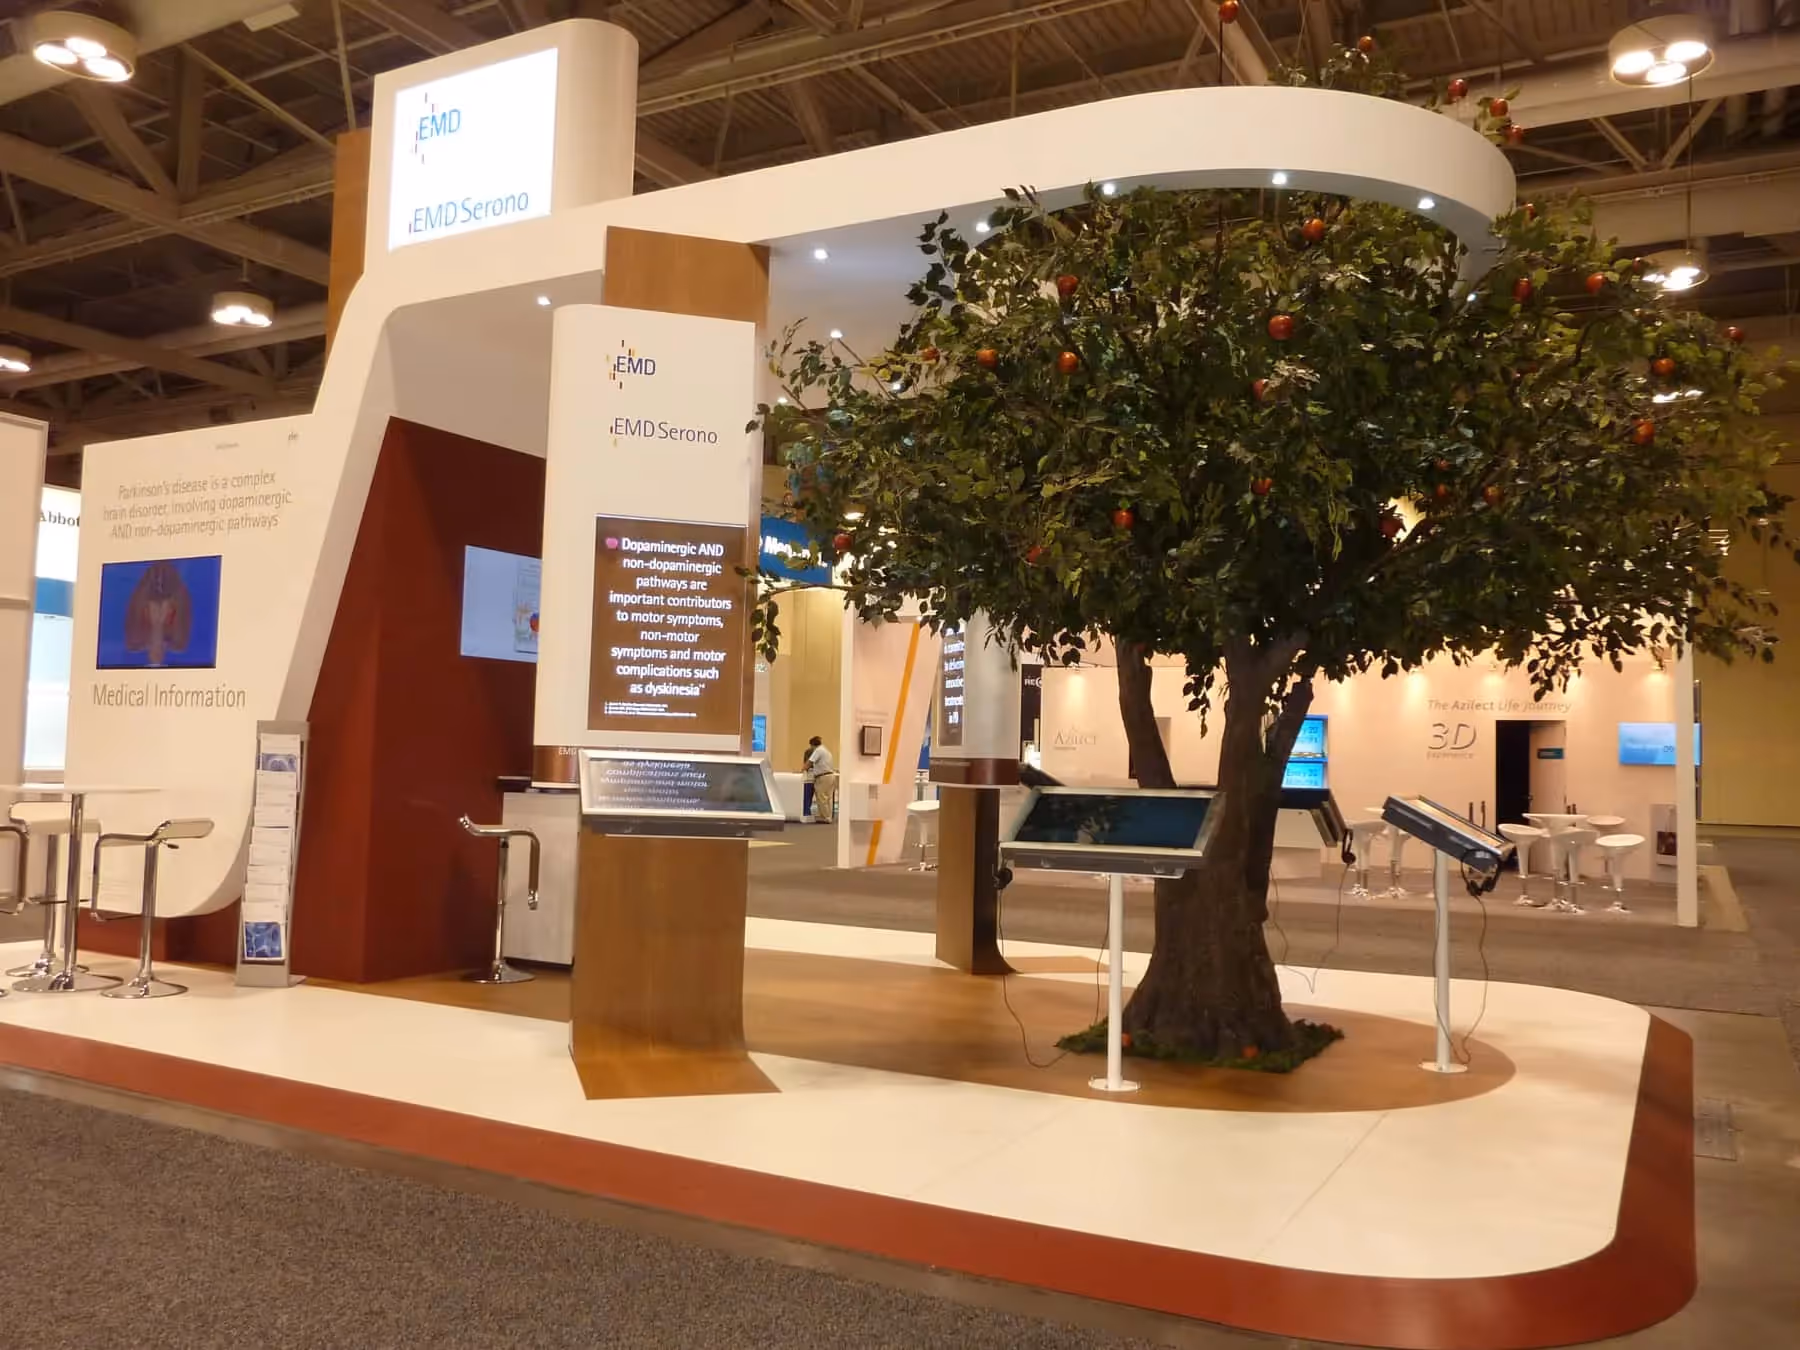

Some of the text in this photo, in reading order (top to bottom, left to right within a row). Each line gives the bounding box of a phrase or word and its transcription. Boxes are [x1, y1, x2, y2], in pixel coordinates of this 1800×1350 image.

[418, 108, 461, 141] EMD
[412, 192, 529, 233] EMD Serono
[616, 356, 656, 376] EMD
[613, 417, 718, 444] EMD Serono
[118, 469, 276, 500] Parkinson's disease is a complex
[103, 503, 127, 521] brain
[171, 496, 216, 517] involving
[218, 489, 292, 511] dopaminergic
[110, 513, 279, 540] AND non-dopaminergic pathways
[621, 537, 724, 557] Dopaminergic AND
[623, 558, 722, 576] non-dopaminergic
[636, 576, 708, 592] pathways are
[609, 590, 732, 610] important contributors
[616, 610, 724, 628] to motor symptoms,
[640, 630, 700, 642] non-motor
[611, 646, 727, 661] symptoms and motor
[616, 664, 720, 680] complications such
[93, 682, 246, 708] Medical Information
[630, 683, 643, 694] as
[1427, 700, 1449, 711] The
[1451, 700, 1494, 711] Azilect
[1498, 700, 1520, 712] Life
[1428, 722, 1477, 750] 3D
